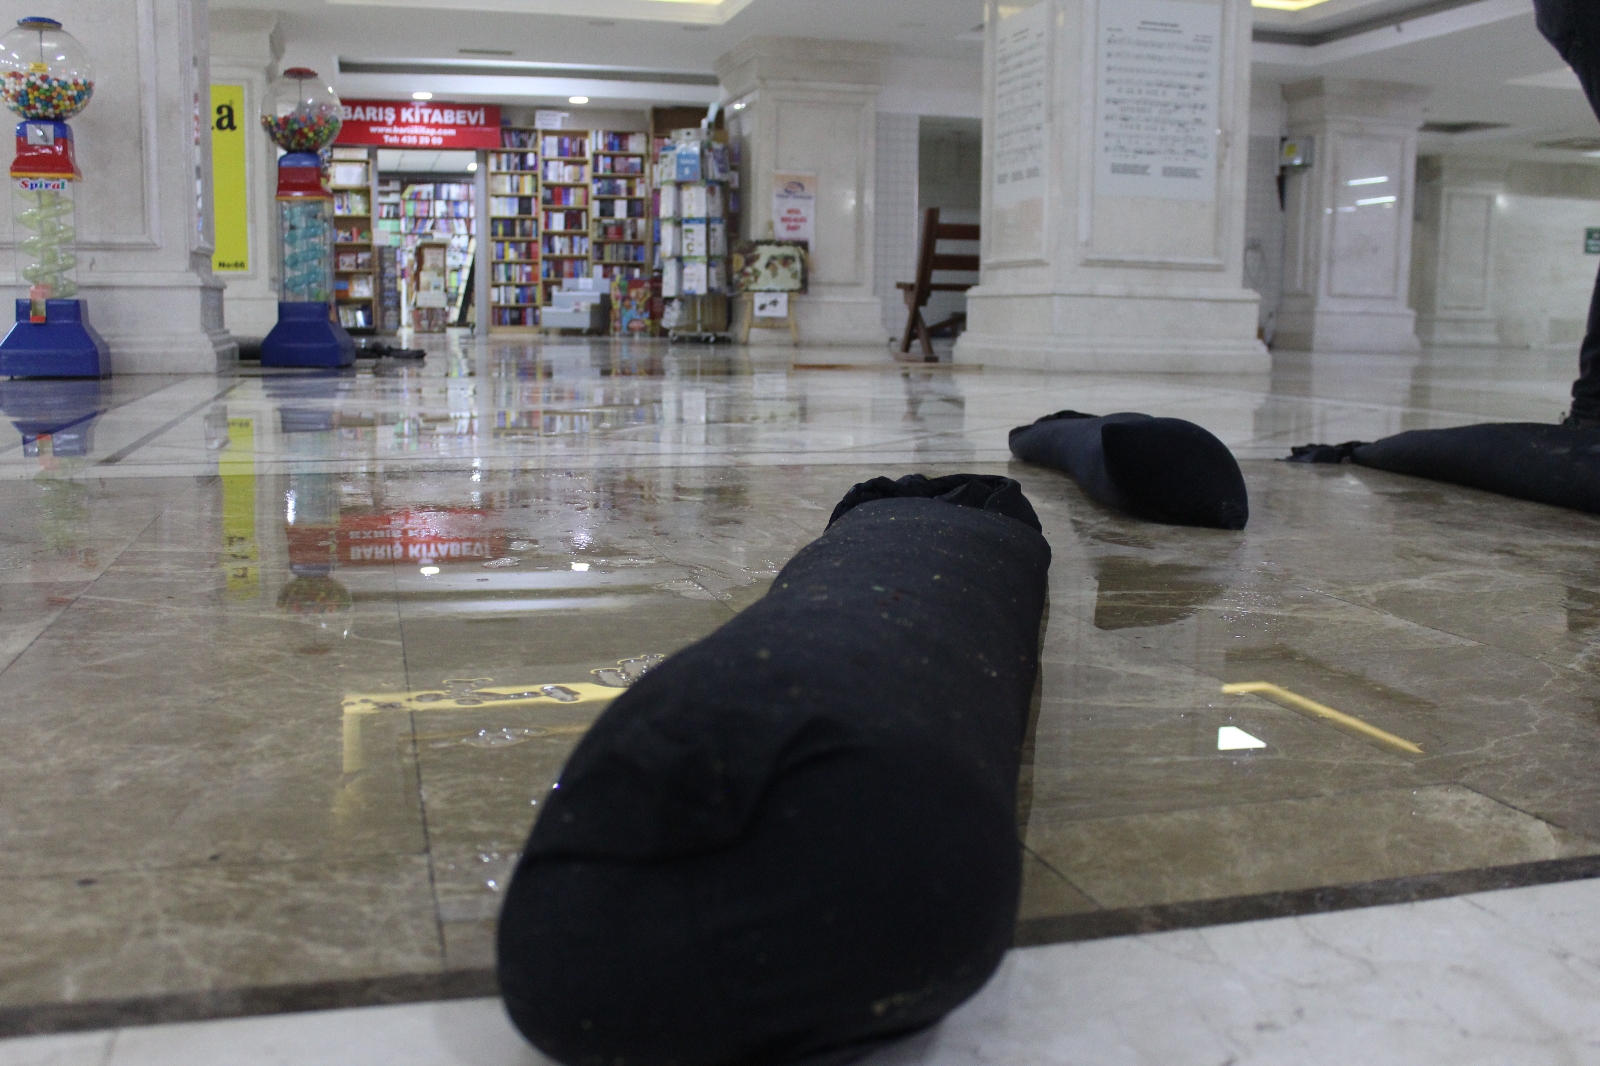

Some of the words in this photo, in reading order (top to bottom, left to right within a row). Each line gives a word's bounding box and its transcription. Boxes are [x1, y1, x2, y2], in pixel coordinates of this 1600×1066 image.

[341, 105, 396, 126] BARIŞ
[401, 105, 485, 125] KİTABEVİ
[20, 180, 66, 190] Spiral
